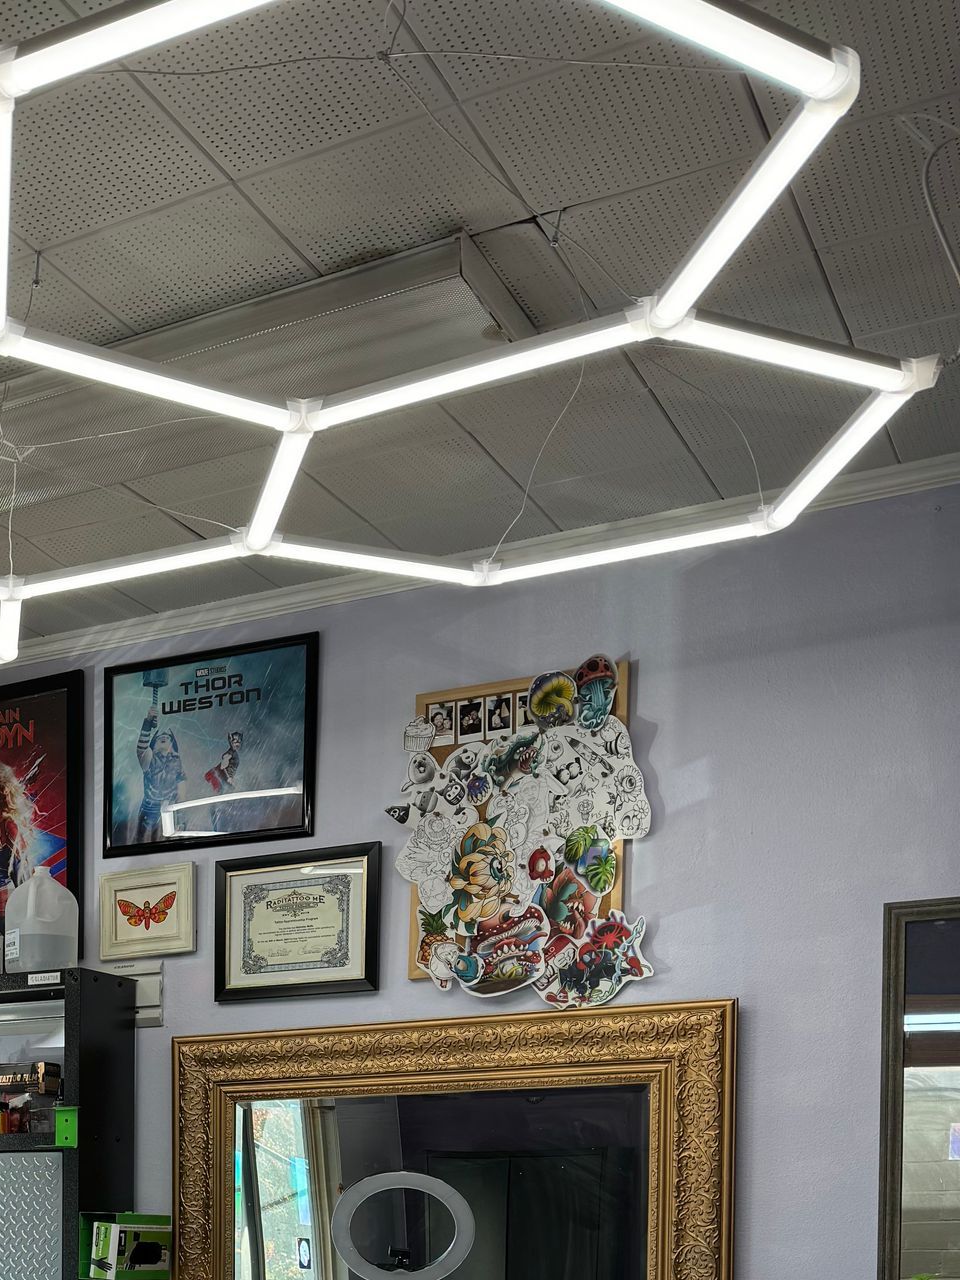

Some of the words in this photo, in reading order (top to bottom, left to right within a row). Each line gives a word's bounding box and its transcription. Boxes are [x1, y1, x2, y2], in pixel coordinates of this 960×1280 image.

[179, 673, 243, 695] THOR
[162, 688, 261, 715] WESTON
[0, 1073, 21, 1083] TATTOO
[23, 1072, 38, 1083] FILM
